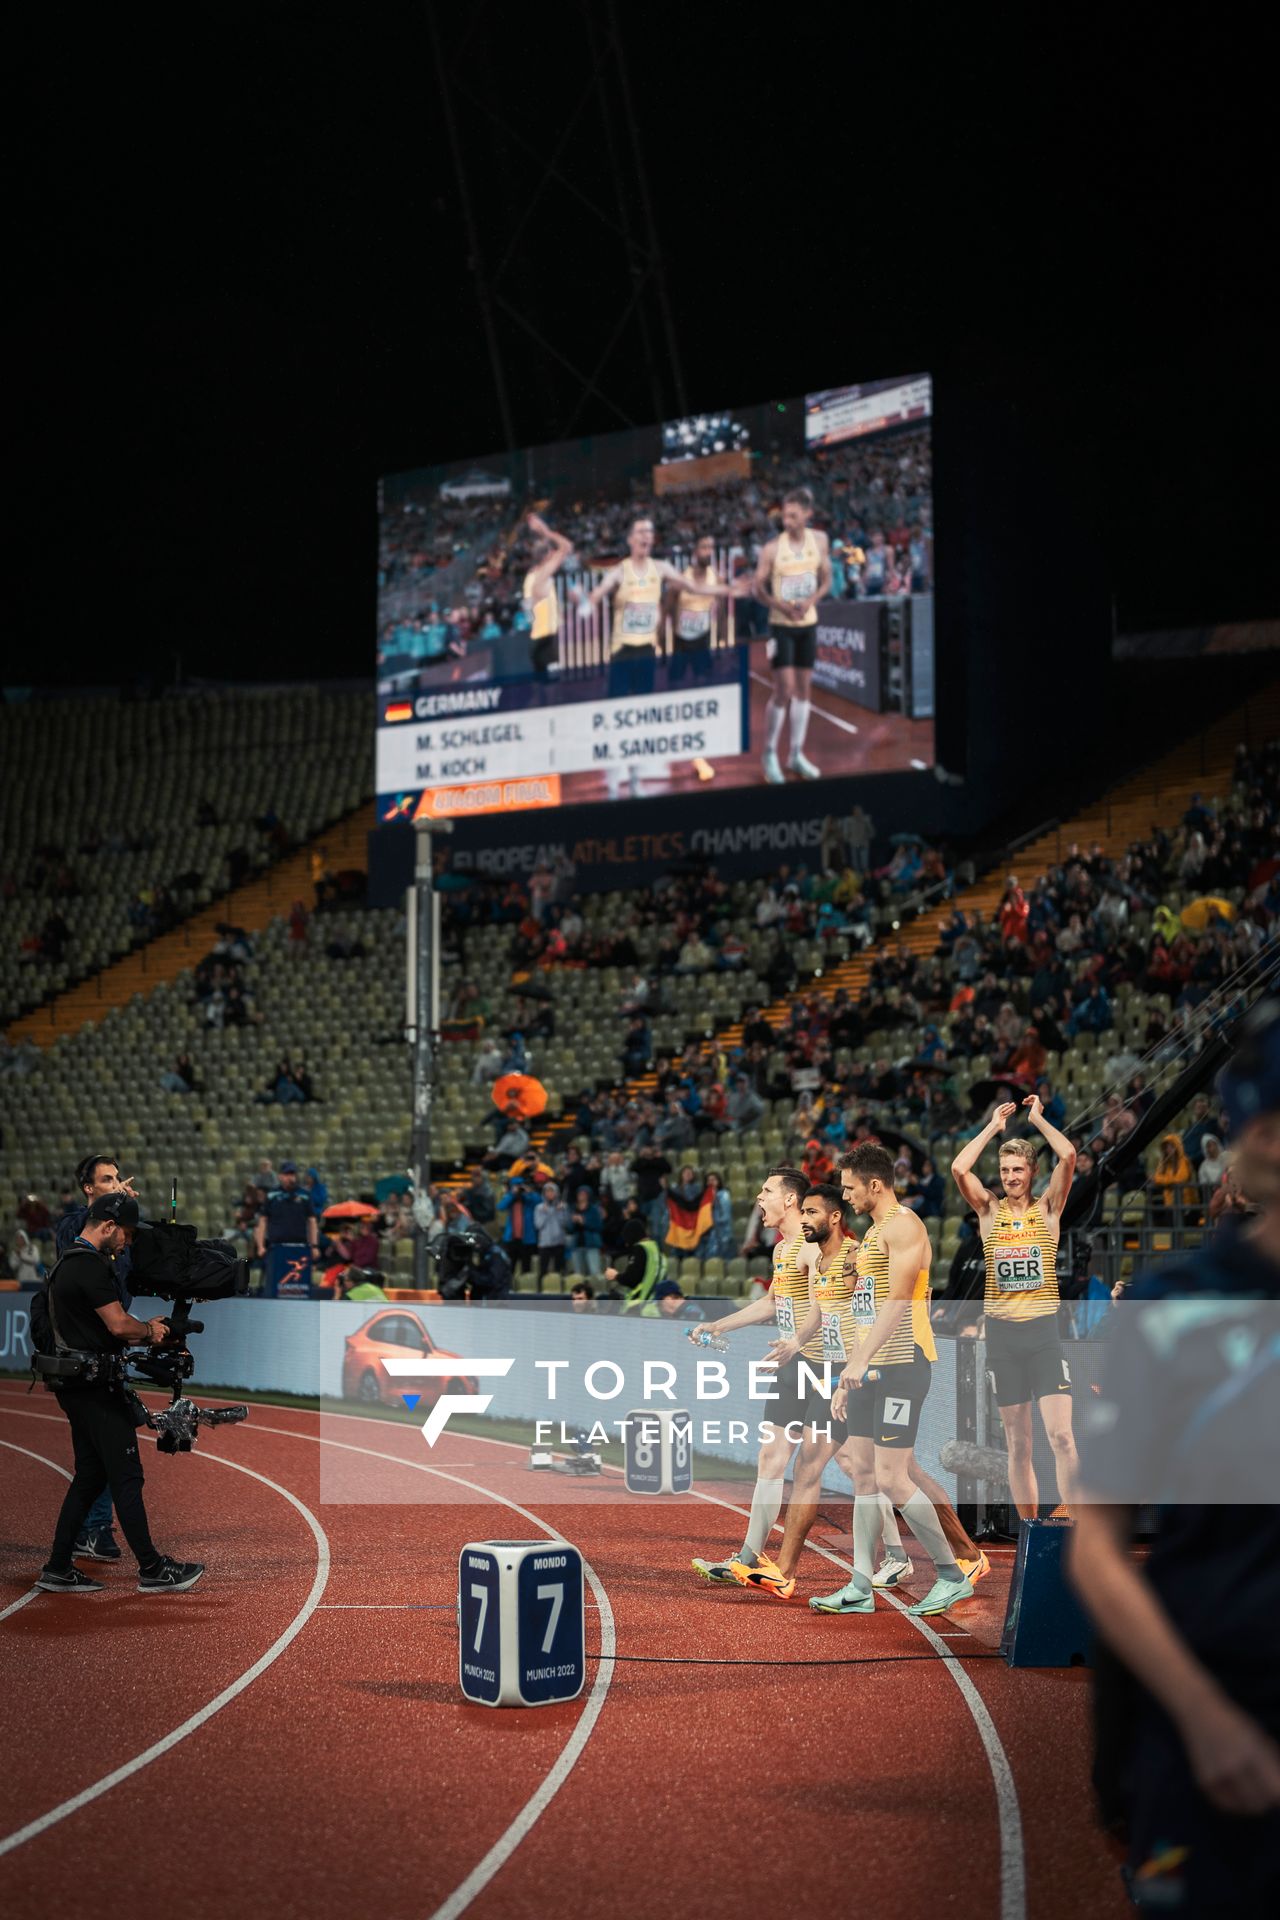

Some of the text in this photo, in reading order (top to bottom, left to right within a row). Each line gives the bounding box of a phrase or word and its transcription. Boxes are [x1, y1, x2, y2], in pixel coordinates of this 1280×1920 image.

[415, 688, 502, 717] GERMANY
[592, 699, 719, 731] P. SCHNEIDER
[416, 724, 523, 752] M. SCHLEGEL
[593, 732, 705, 760] M. SANDERS
[416, 757, 487, 780] M. KOCH
[504, 780, 552, 805] FINAL
[453, 819, 824, 874] EUROPEAN ATHLETICS CHAMPIONS
[998, 1231, 1037, 1240] GERMANY
[995, 1248, 1029, 1259] SPAR
[998, 1260, 1041, 1277] GER
[854, 1277, 865, 1290] AR
[999, 1281, 1042, 1290] MUNICH 2022
[777, 1309, 793, 1328] ER
[822, 1327, 842, 1346] ER
[892, 1402, 905, 1420] 7
[635, 1430, 654, 1469] 8
[468, 1556, 490, 1572] MONDO
[533, 1555, 567, 1571] MONDO
[470, 1583, 488, 1654] 7
[537, 1582, 564, 1654] 7
[464, 1663, 496, 1683] MUNICH 2022
[526, 1663, 576, 1682] MUNICH 2022
